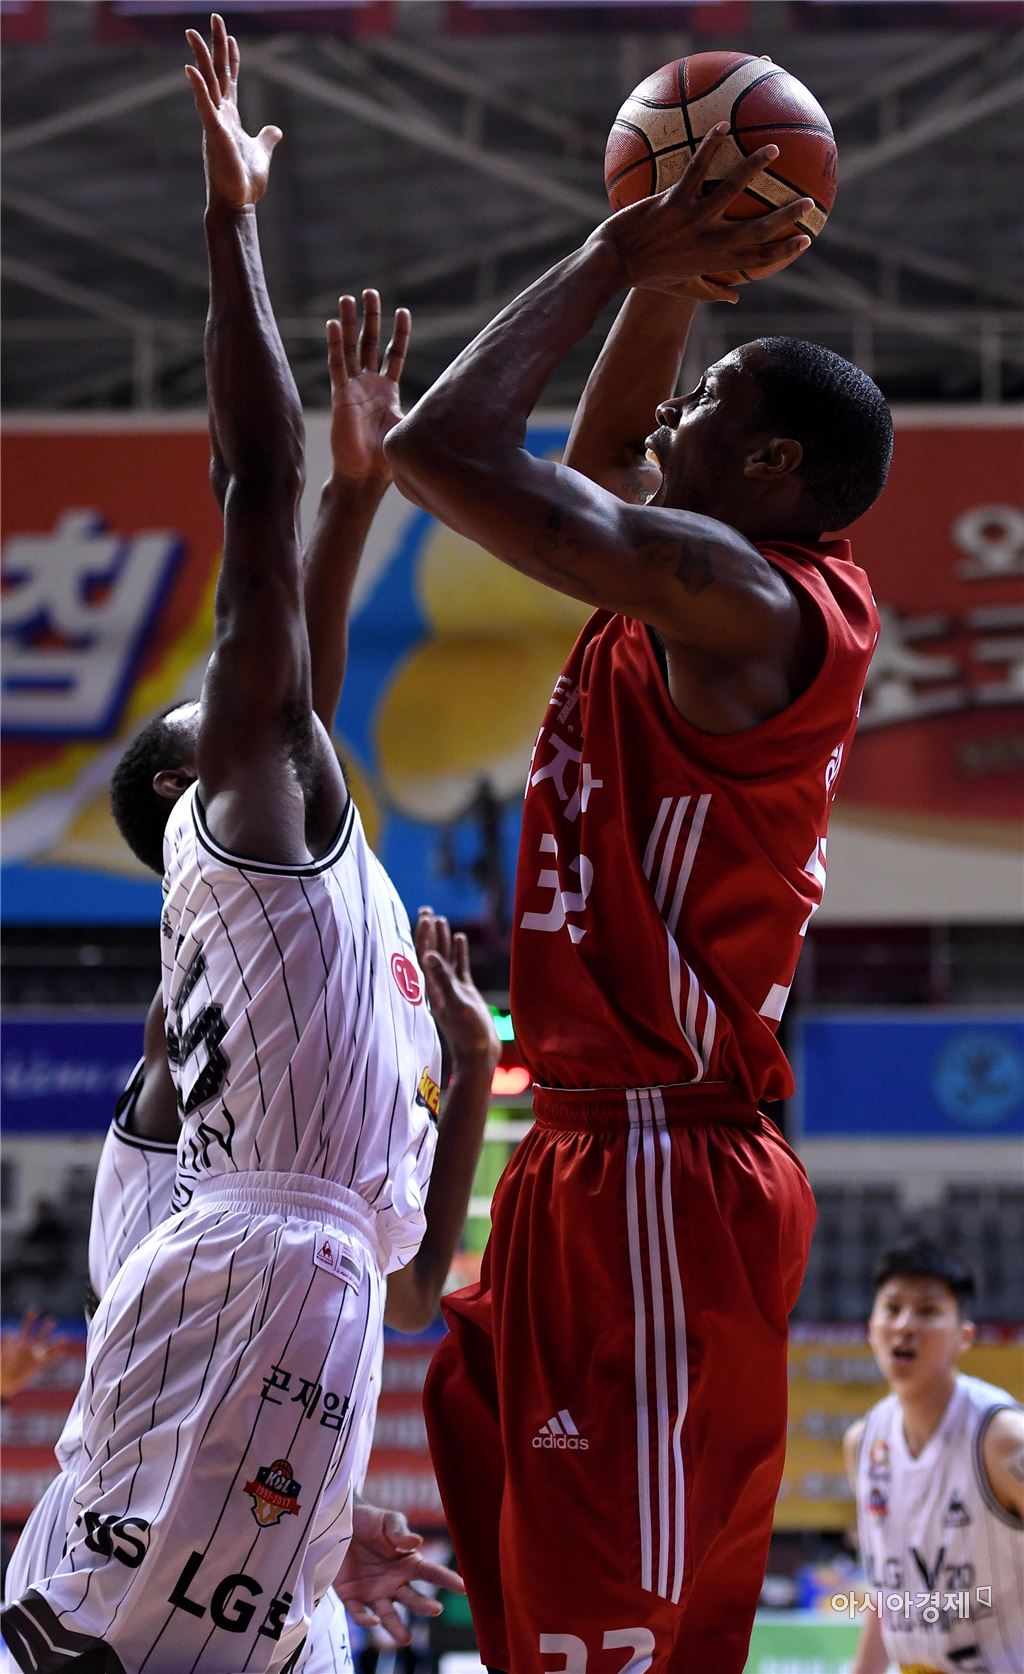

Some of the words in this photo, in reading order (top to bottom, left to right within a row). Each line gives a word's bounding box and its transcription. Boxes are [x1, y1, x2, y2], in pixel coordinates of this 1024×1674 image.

[260, 1364, 350, 1432] 곤지암
[532, 1433, 590, 1451] adidas
[255, 1484, 292, 1508] 1997-2017
